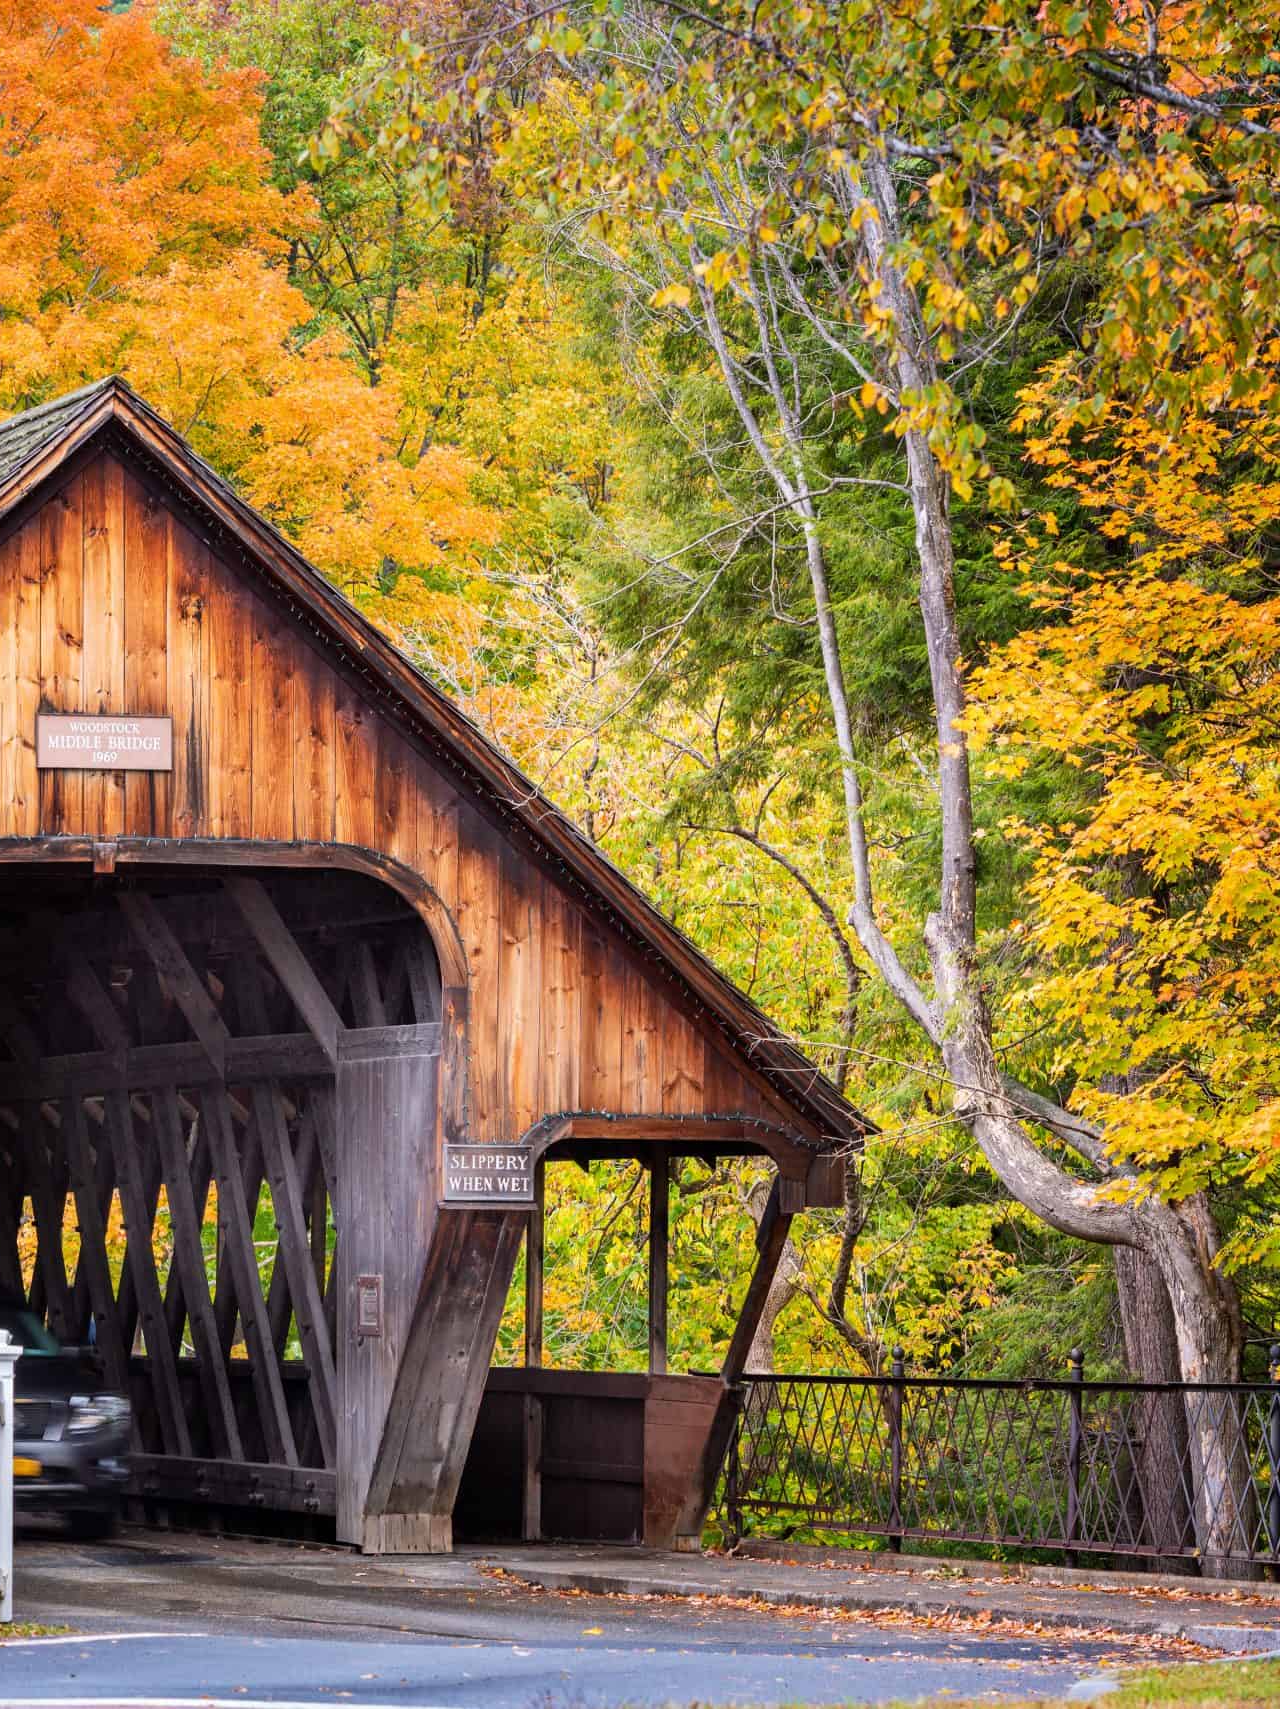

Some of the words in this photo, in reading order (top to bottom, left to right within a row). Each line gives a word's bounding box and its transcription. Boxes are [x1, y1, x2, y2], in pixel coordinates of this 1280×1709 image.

[70, 721, 140, 733] WOODSTOCK
[48, 735, 101, 749] MIDDLE
[108, 737, 161, 751] BRIDGE
[92, 751, 118, 762] 1969
[451, 1154, 529, 1170] SLIPPERY
[449, 1176, 493, 1191] WHEN
[497, 1177, 530, 1192] WET
